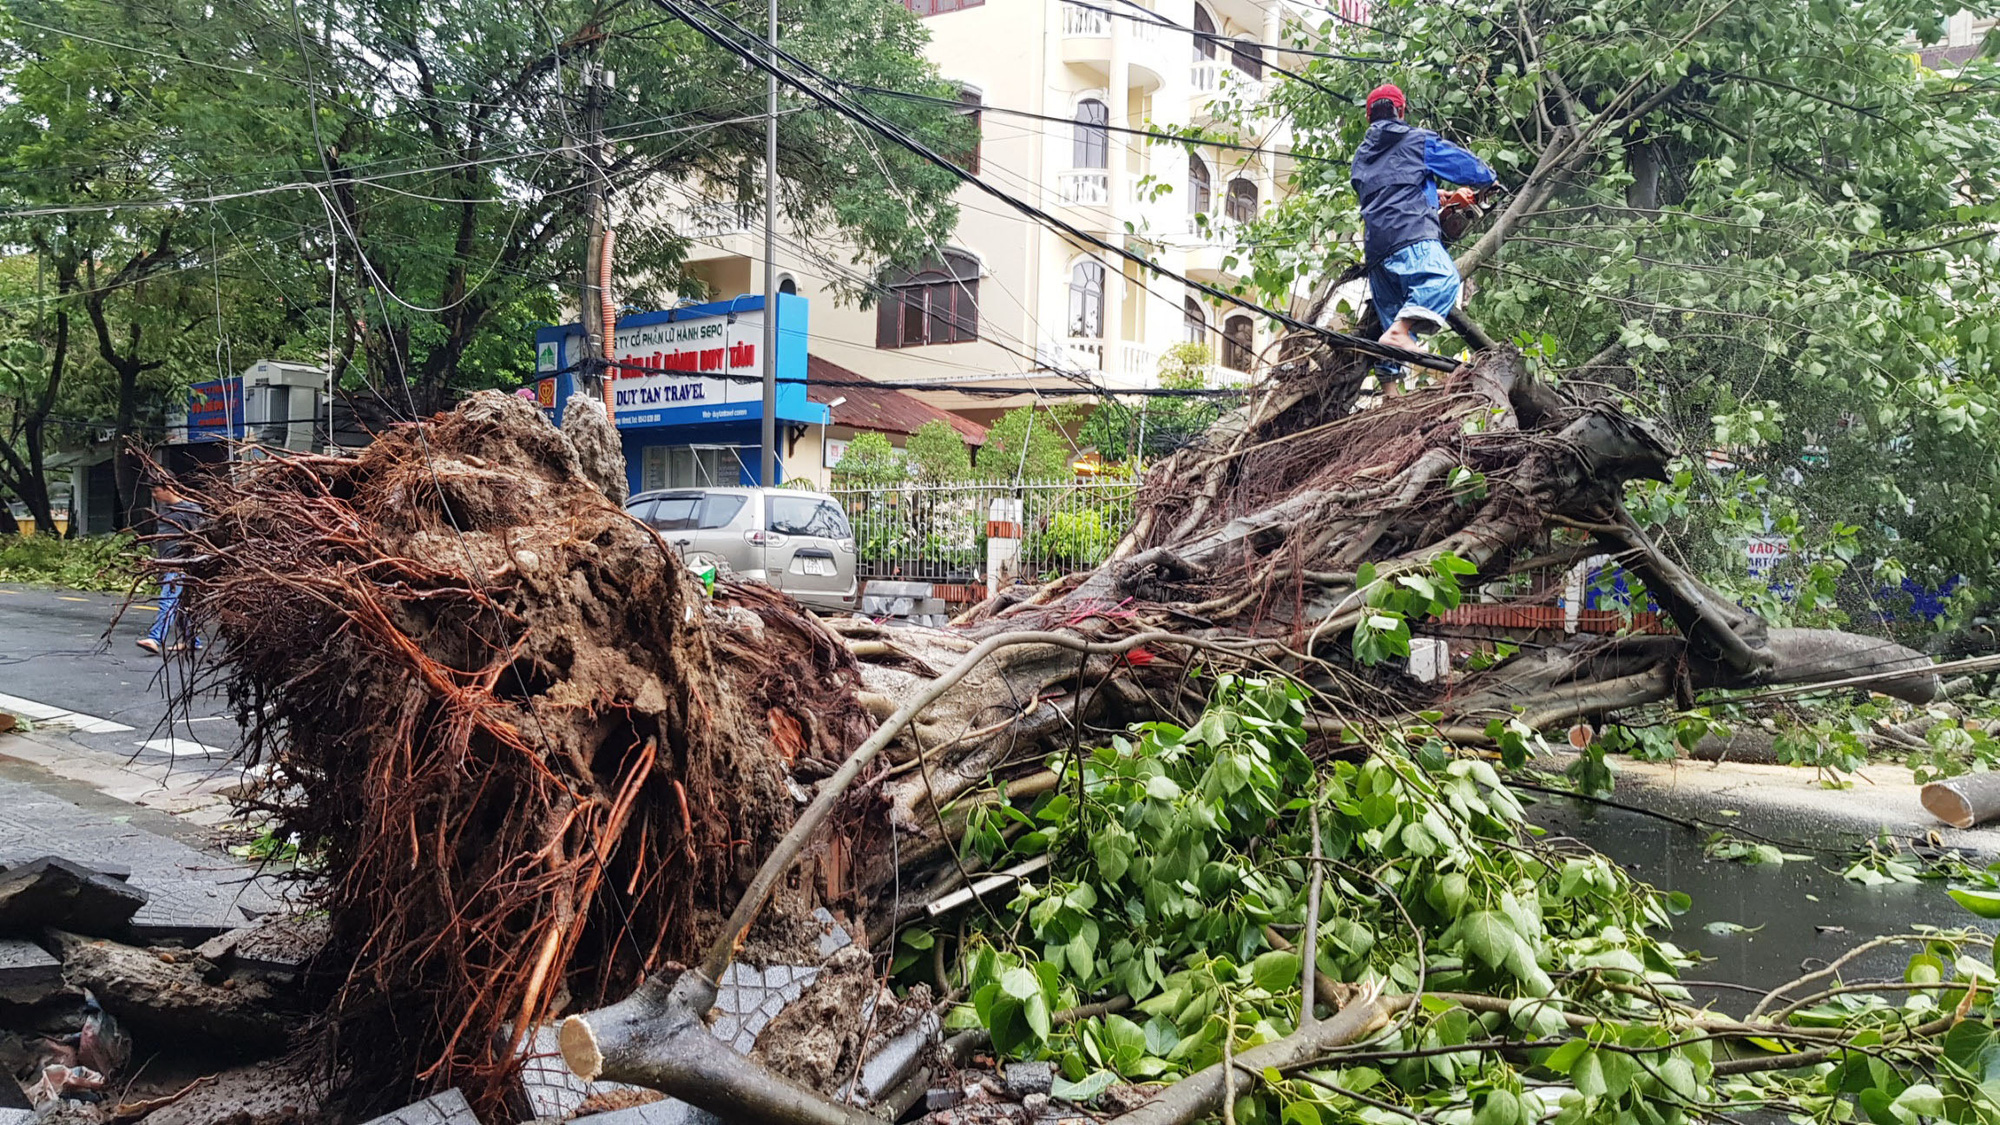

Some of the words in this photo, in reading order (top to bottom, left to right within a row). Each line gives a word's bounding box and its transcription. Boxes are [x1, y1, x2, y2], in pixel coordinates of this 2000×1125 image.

[619, 335, 630, 349] TY
[677, 324, 699, 341] HÀNH
[700, 323, 723, 338] SEPO
[700, 347, 725, 372] DUY
[616, 389, 639, 406] DUY
[640, 386, 662, 404] TAN
[664, 382, 706, 401] TRAVEL
